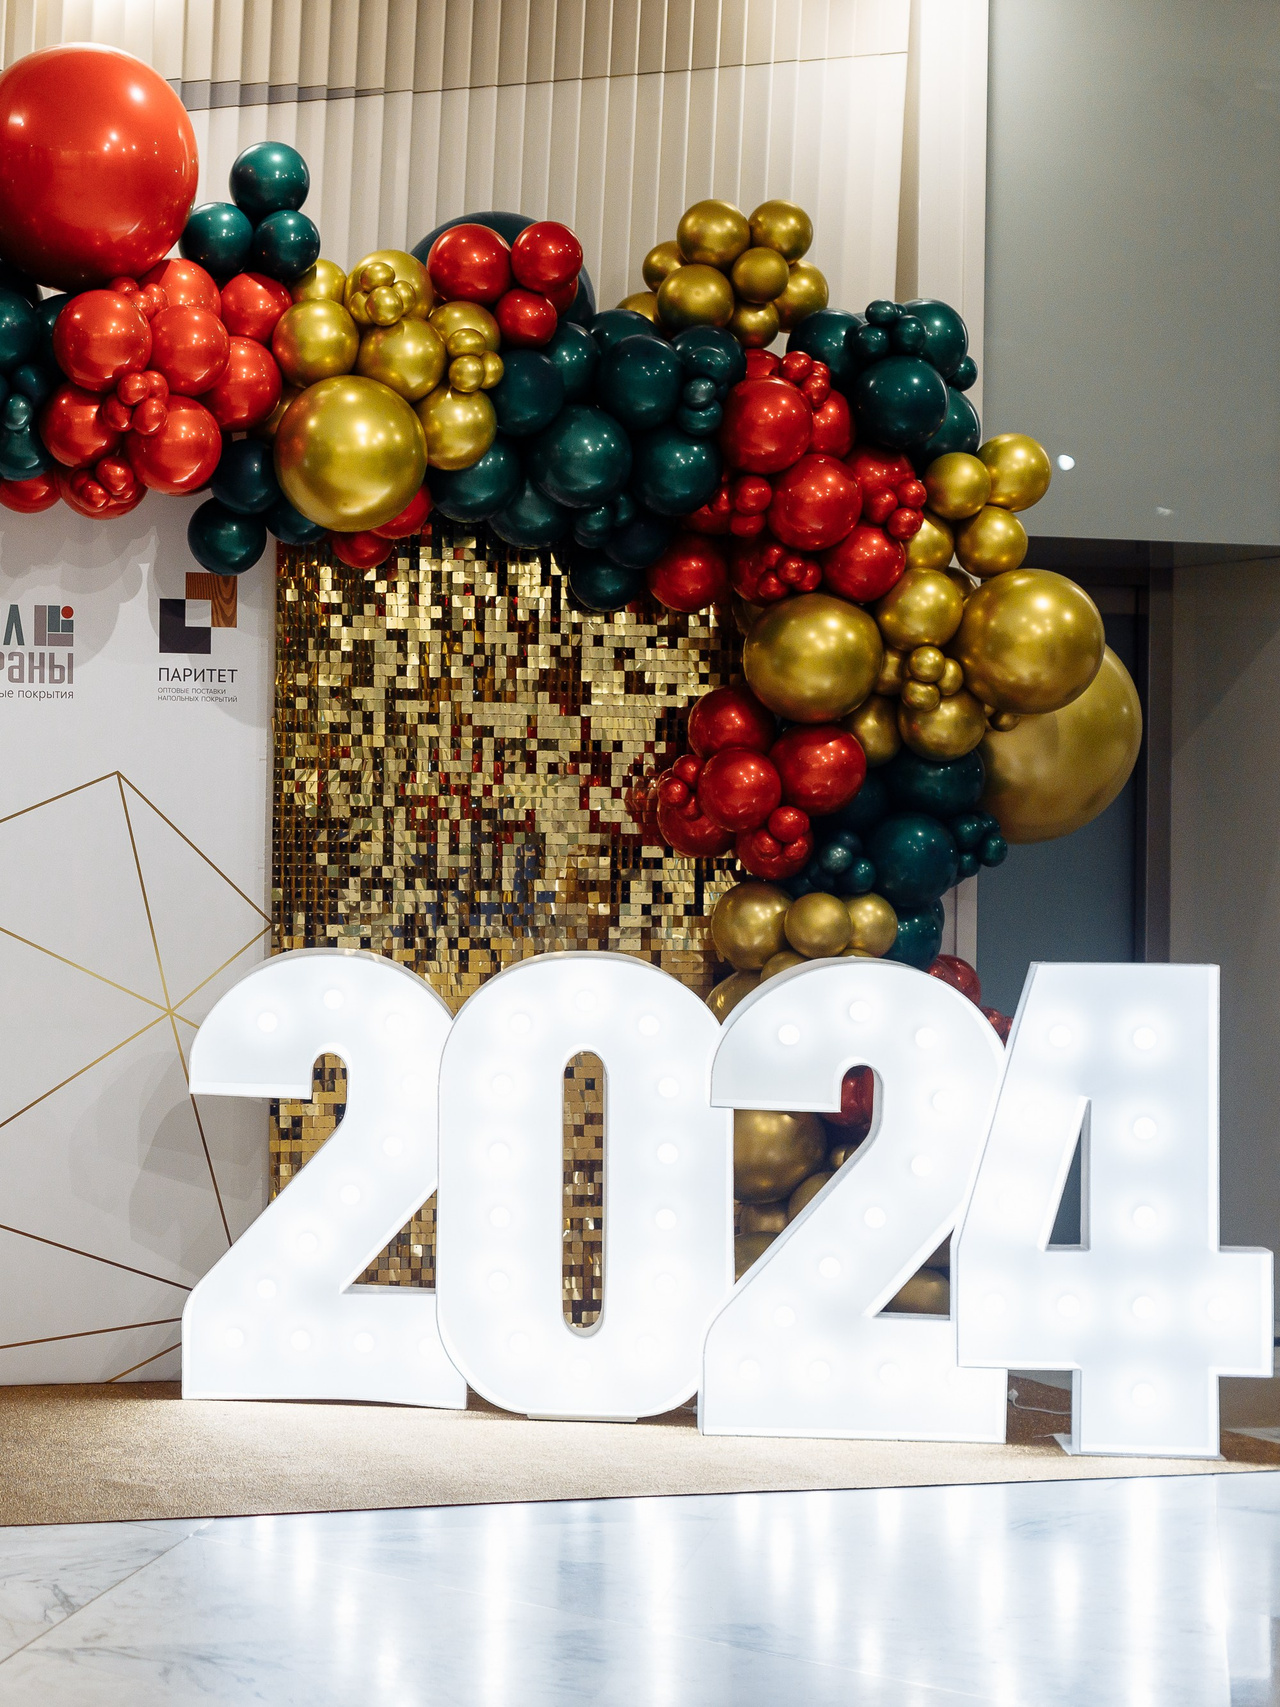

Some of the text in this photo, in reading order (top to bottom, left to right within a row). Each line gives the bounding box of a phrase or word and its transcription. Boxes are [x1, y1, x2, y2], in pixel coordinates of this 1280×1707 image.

[158, 667, 238, 683] ПАРИТЕТ
[18, 689, 74, 701] покрытия
[201, 695, 238, 703] ПОКРЫТИЙ
[181, 948, 1275, 1458] 2024
